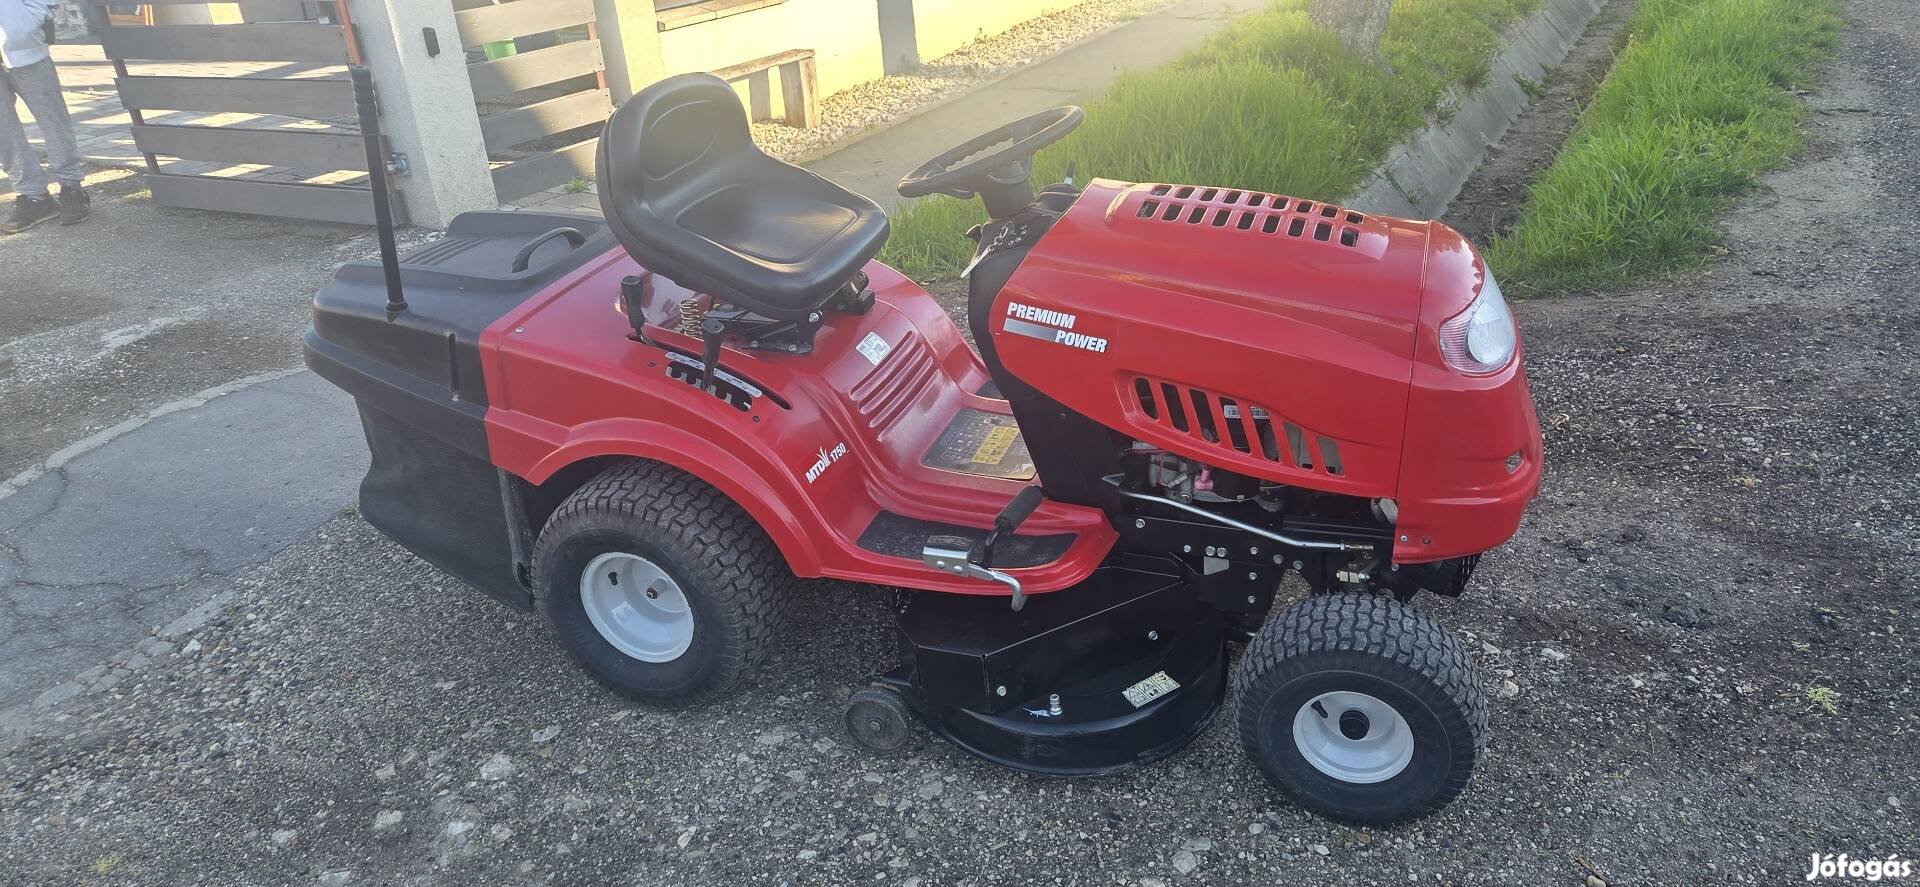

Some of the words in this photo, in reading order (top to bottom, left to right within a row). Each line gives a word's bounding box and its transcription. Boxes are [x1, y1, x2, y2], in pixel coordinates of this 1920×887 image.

[1006, 301, 1076, 329] PREMIUM
[1054, 329, 1108, 353] POWER
[805, 459, 826, 484] MTD
[830, 442, 847, 462] 1750
